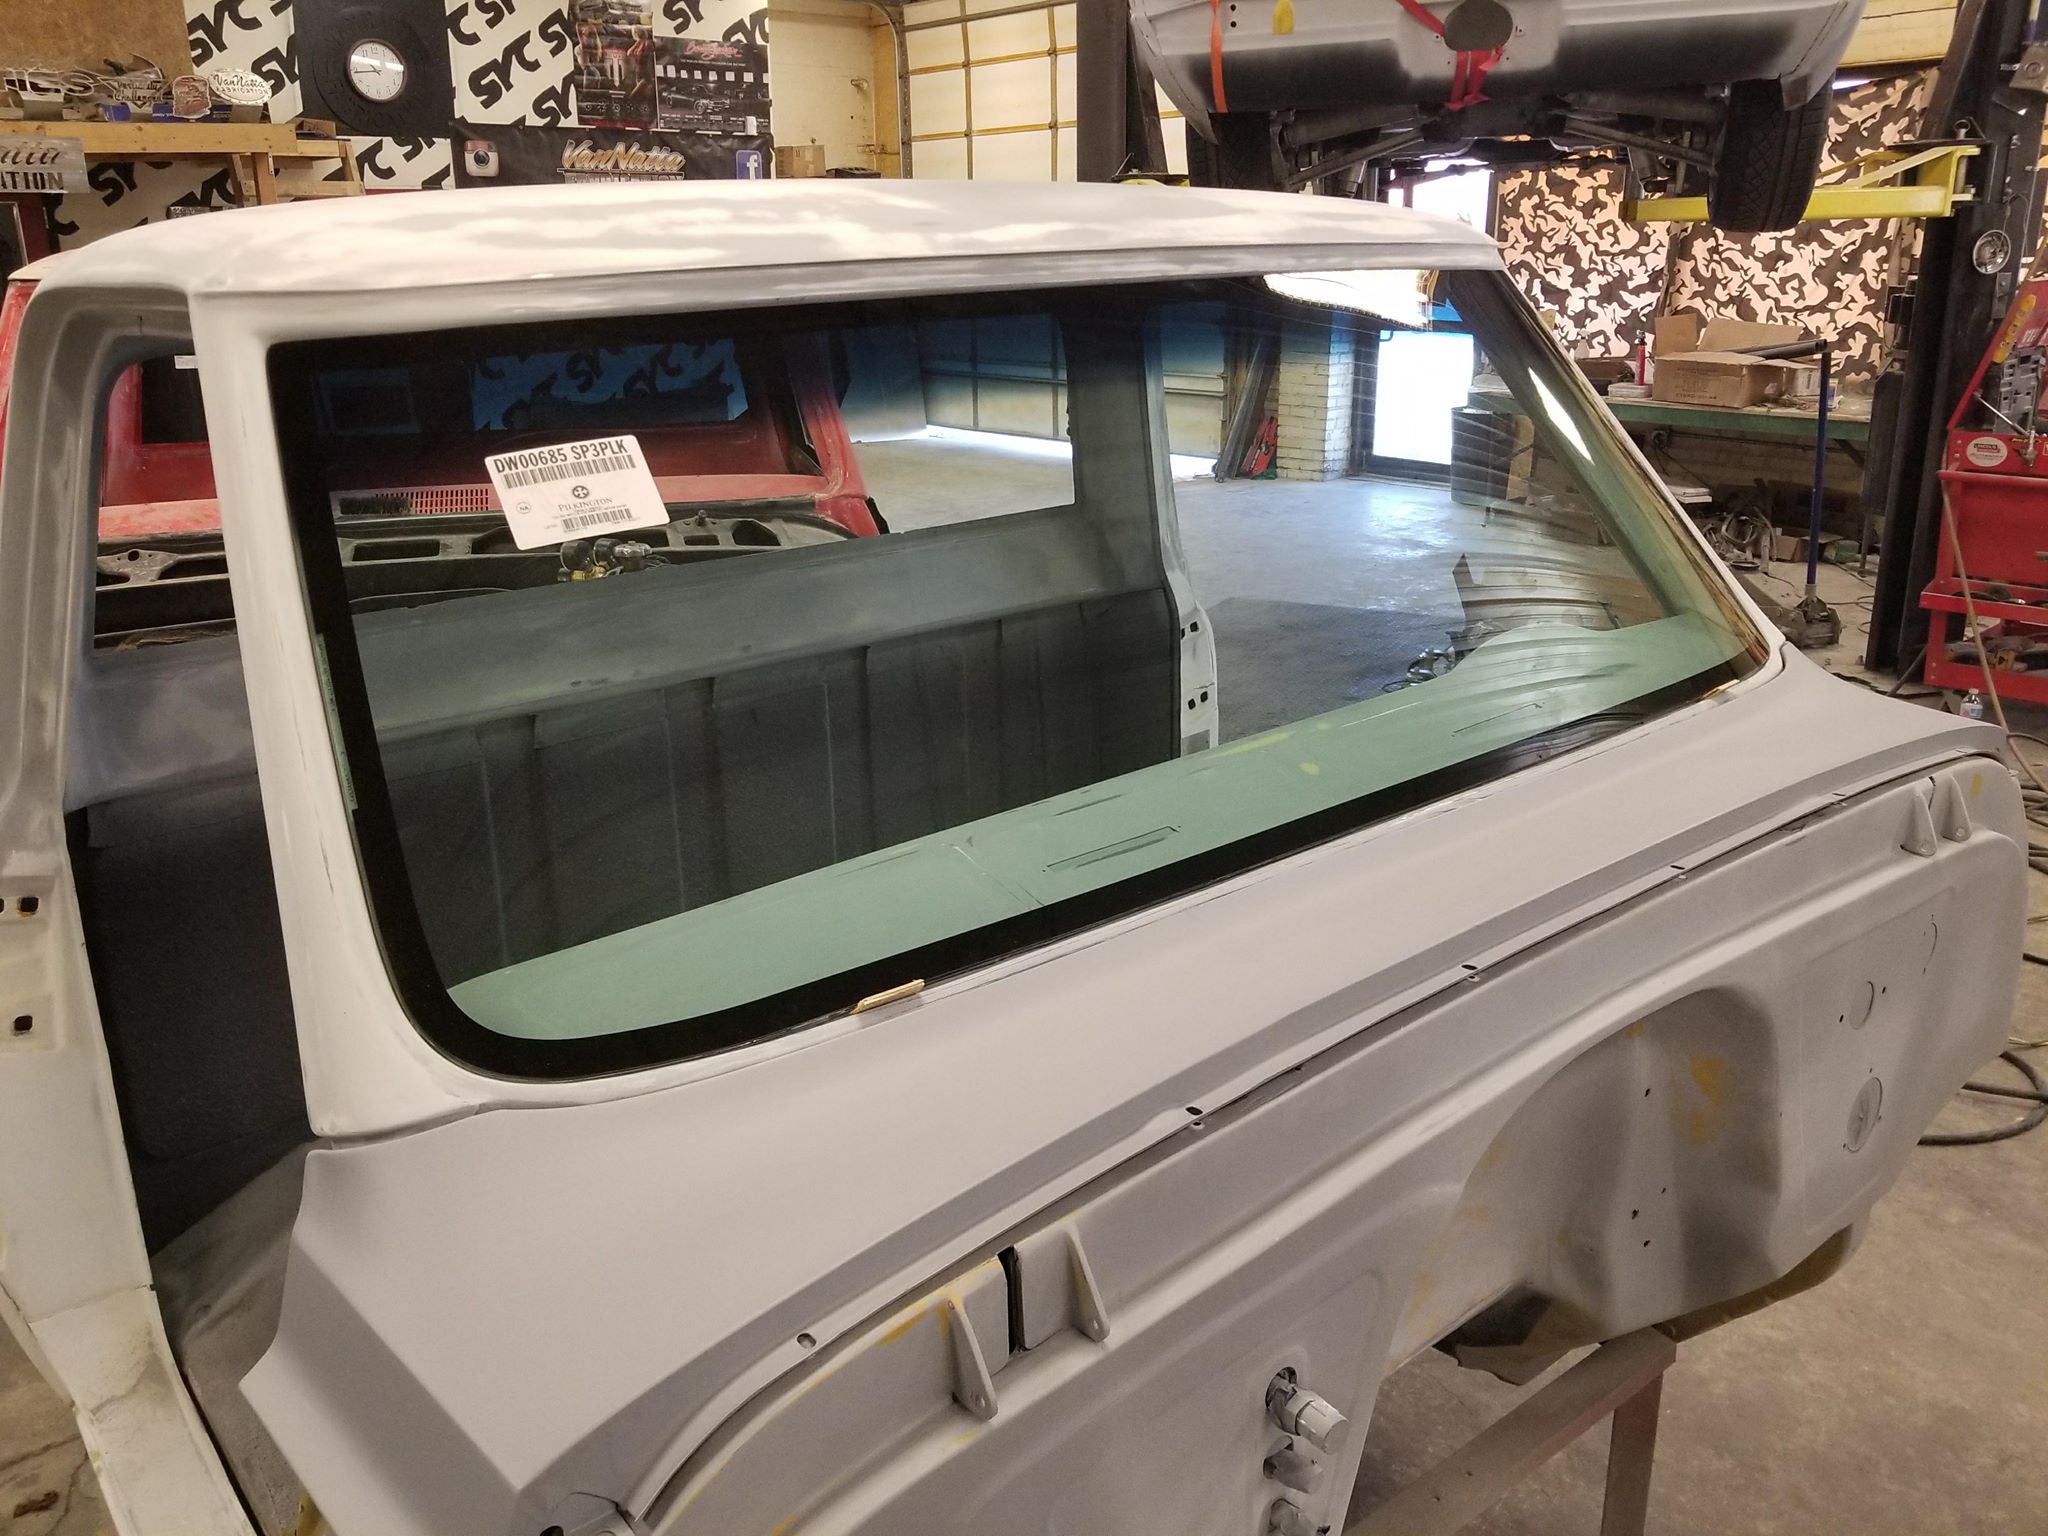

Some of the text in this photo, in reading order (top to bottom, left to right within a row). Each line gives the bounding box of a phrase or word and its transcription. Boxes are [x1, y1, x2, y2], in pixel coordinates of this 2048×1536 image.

[468, 30, 541, 110] SYC
[562, 139, 686, 171] VanNatta
[494, 438, 628, 475] DW00685 SP3PLK
[558, 497, 614, 513] PILKINGTON
